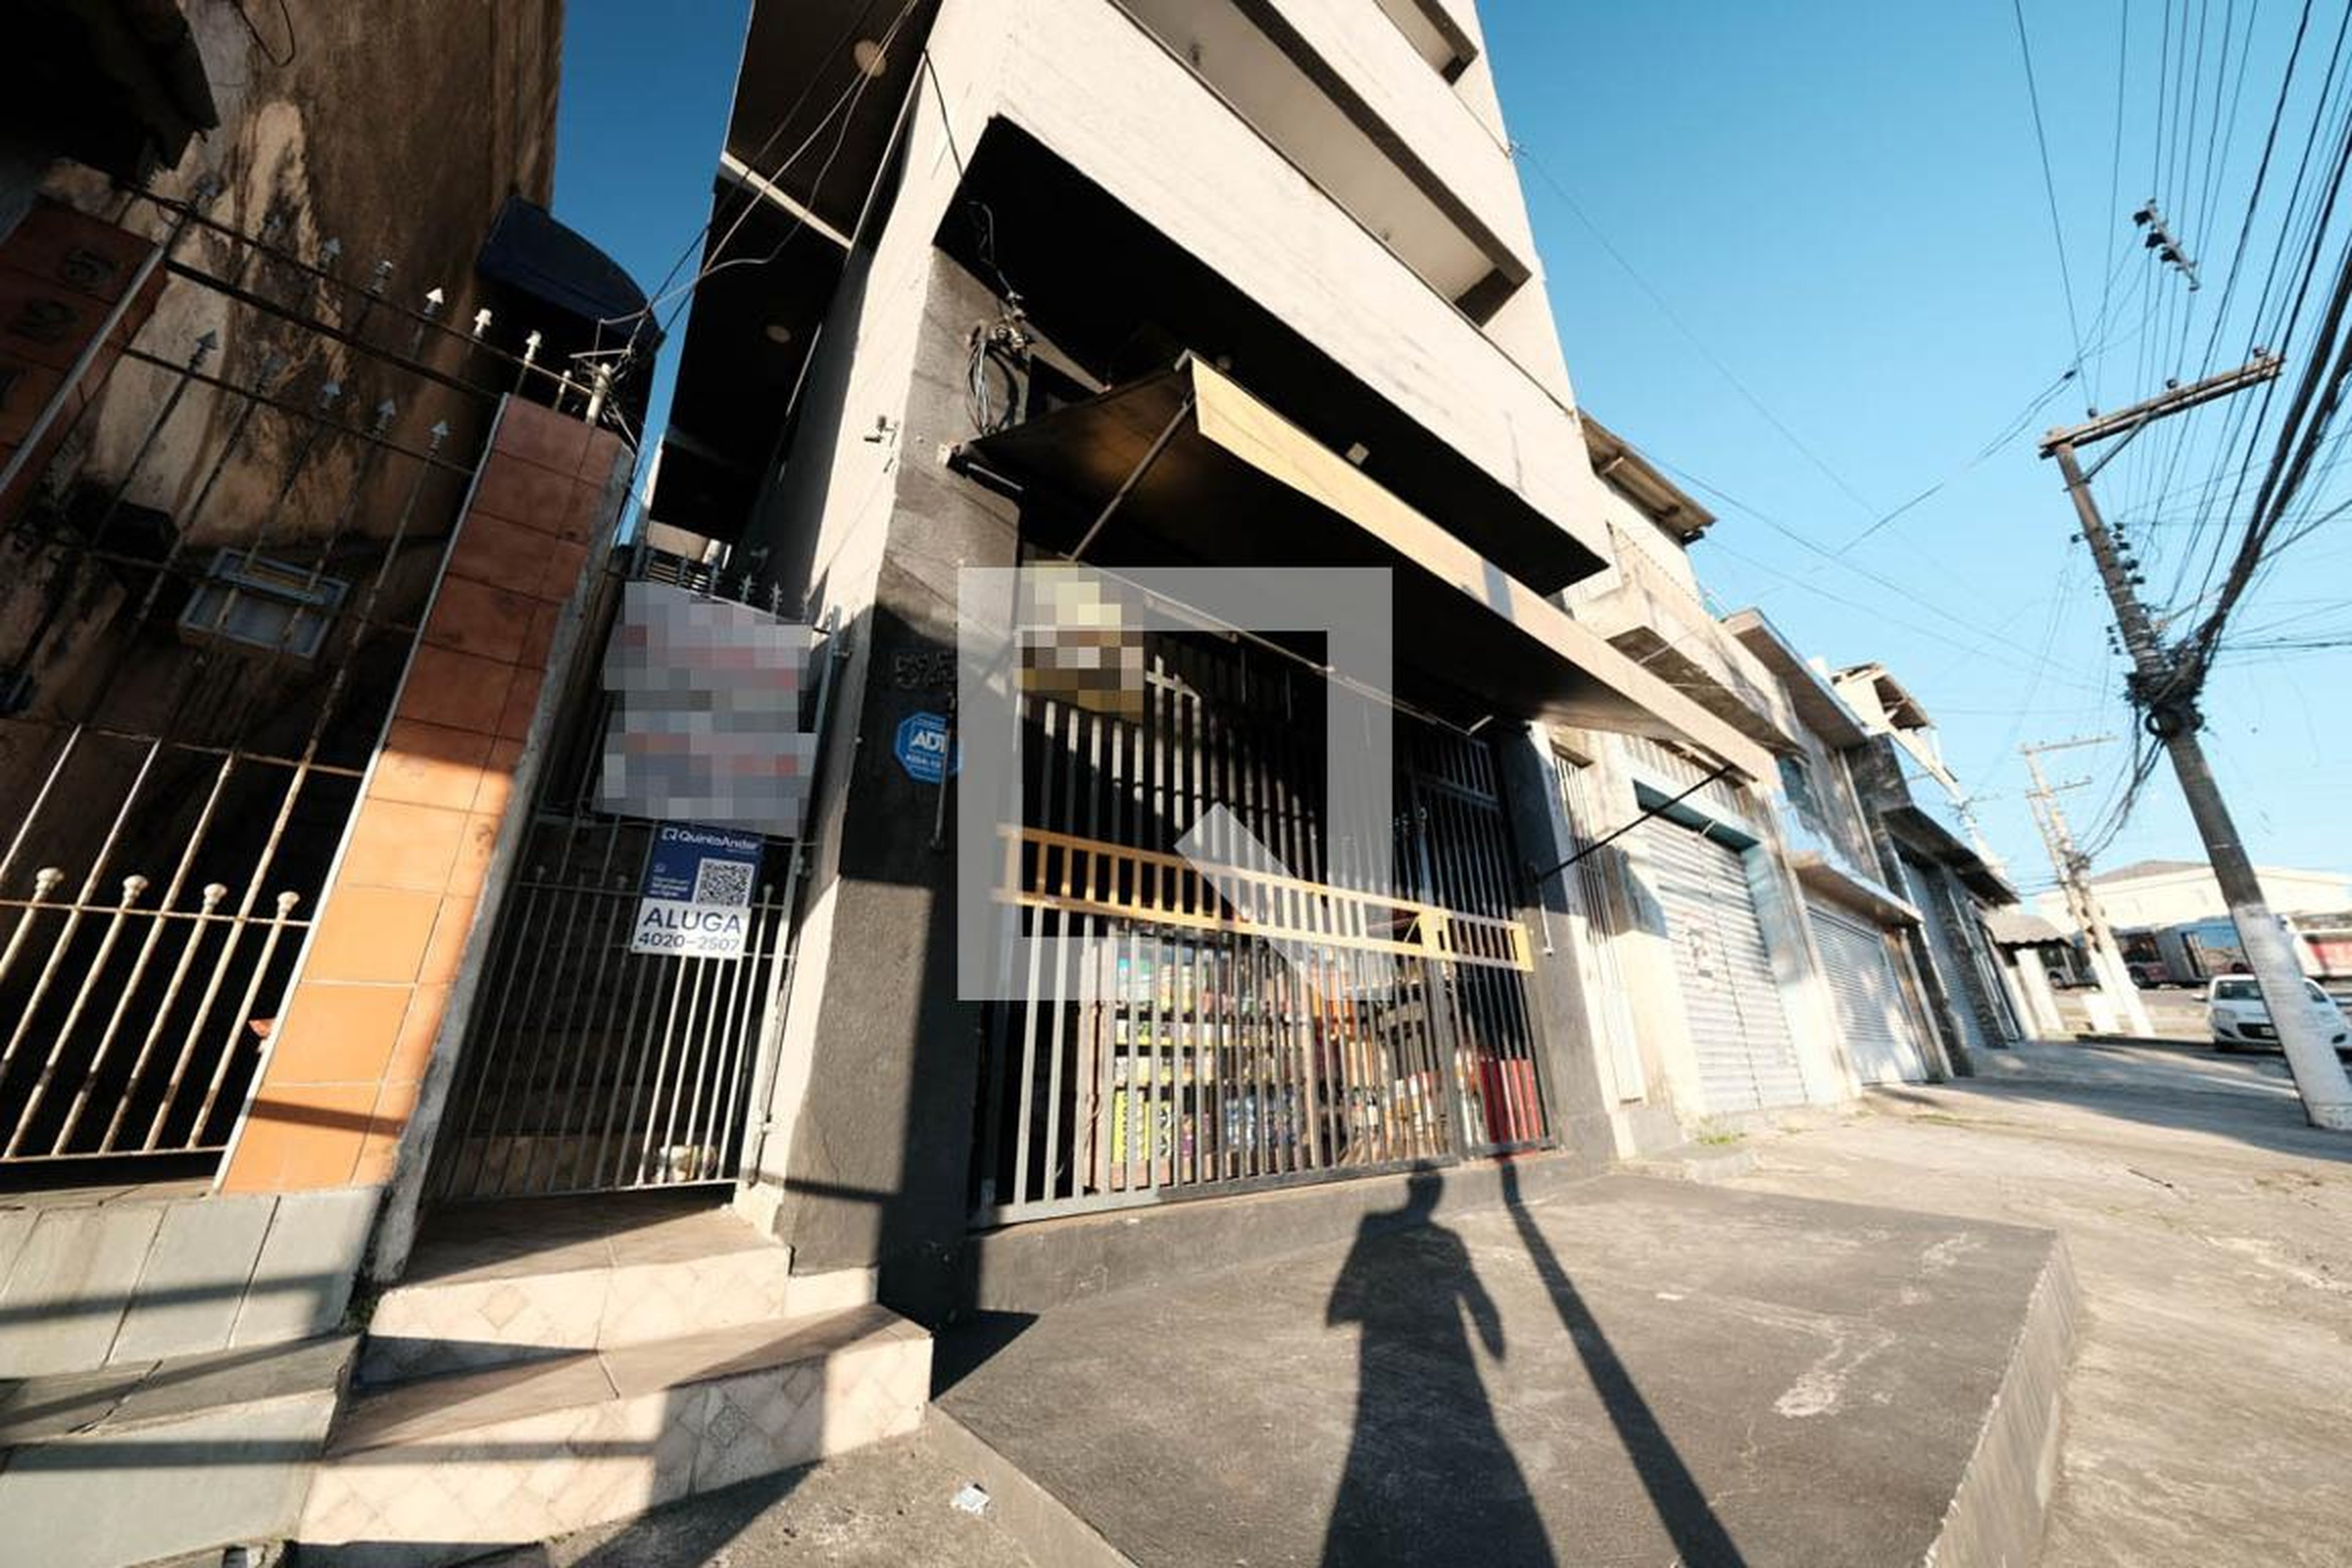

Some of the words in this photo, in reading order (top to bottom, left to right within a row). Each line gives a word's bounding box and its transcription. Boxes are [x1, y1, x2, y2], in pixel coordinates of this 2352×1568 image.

[679, 831, 758, 850] QuintoAndar
[643, 907, 741, 933] ALUGA
[638, 932, 740, 951] 4020-2507
